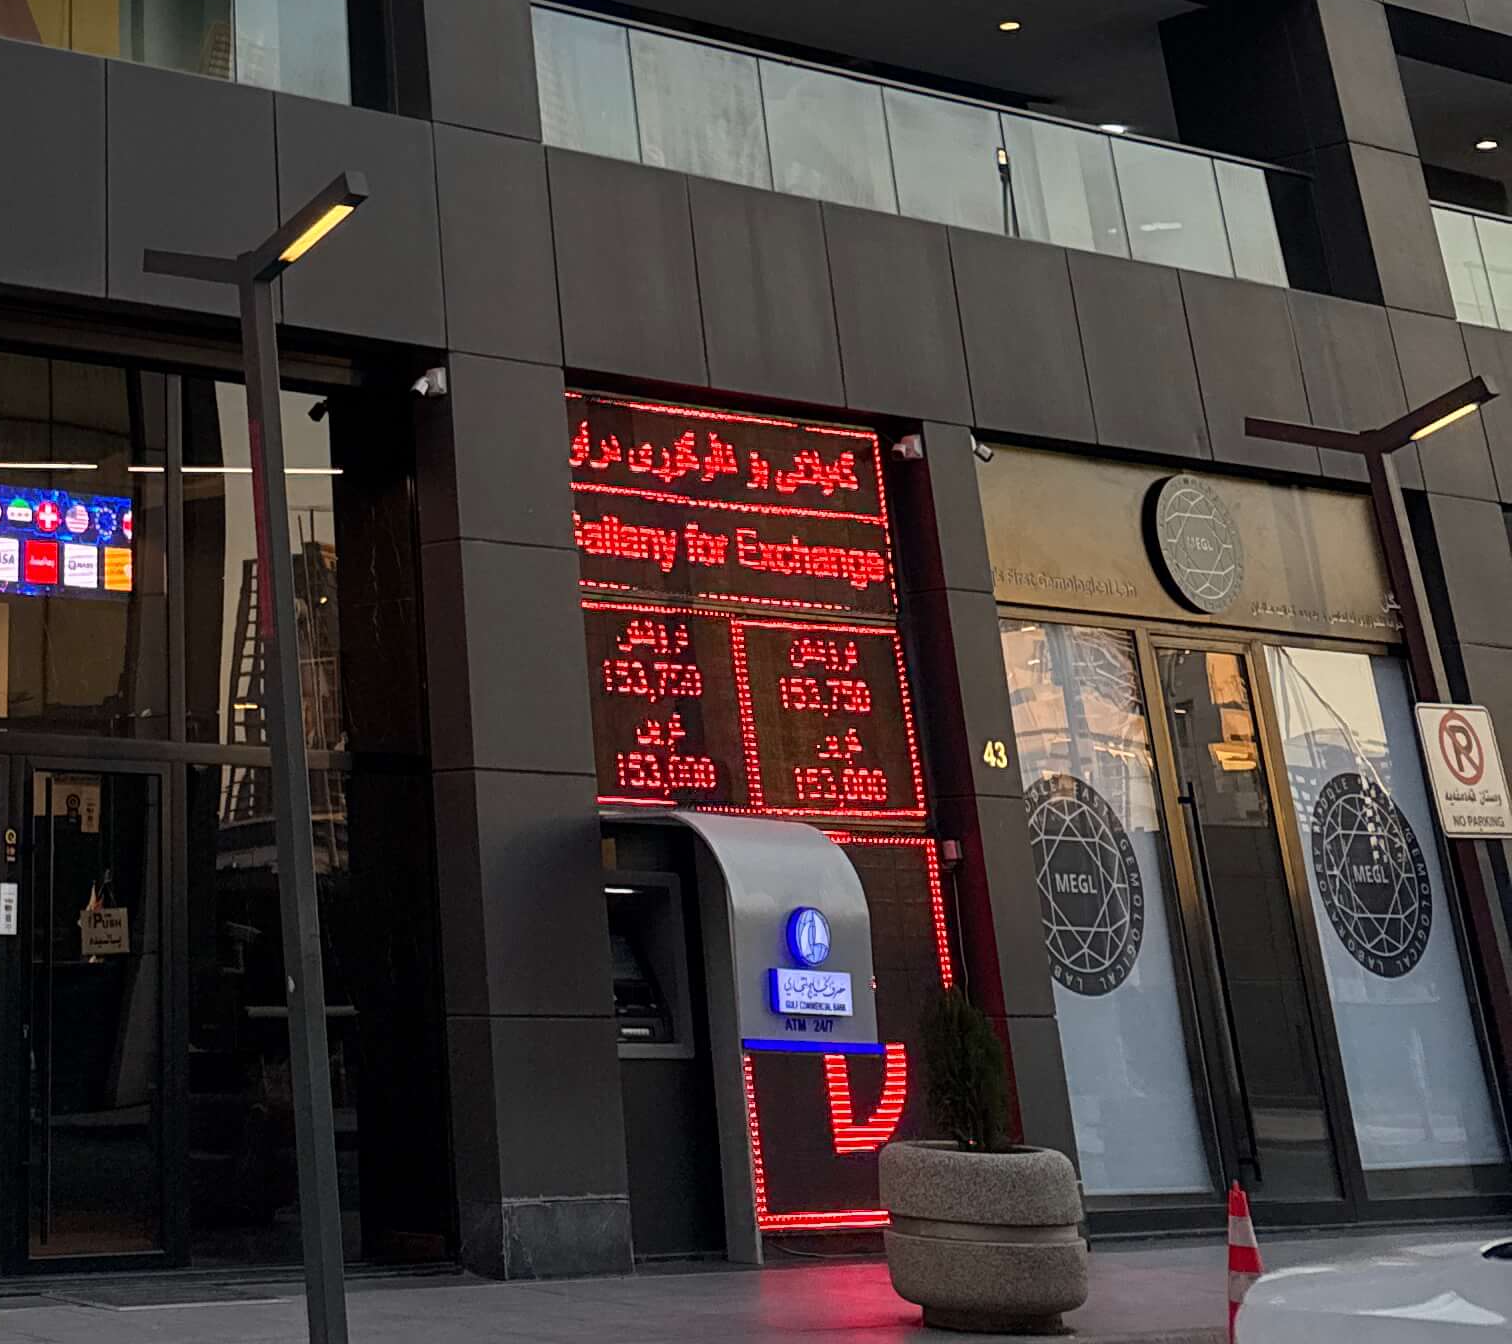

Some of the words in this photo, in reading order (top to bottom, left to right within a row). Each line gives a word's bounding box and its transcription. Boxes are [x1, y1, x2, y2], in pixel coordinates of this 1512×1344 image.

[684, 522, 729, 567] for
[736, 527, 885, 591] Exchange
[983, 740, 1008, 769] 43
[1453, 815, 1466, 827] NO
[1468, 815, 1505, 828] PARKING
[1055, 873, 1098, 894] MEGL
[1352, 864, 1389, 884] MEGL
[785, 1018, 807, 1032] ATM
[814, 1019, 834, 1033] 24/7
